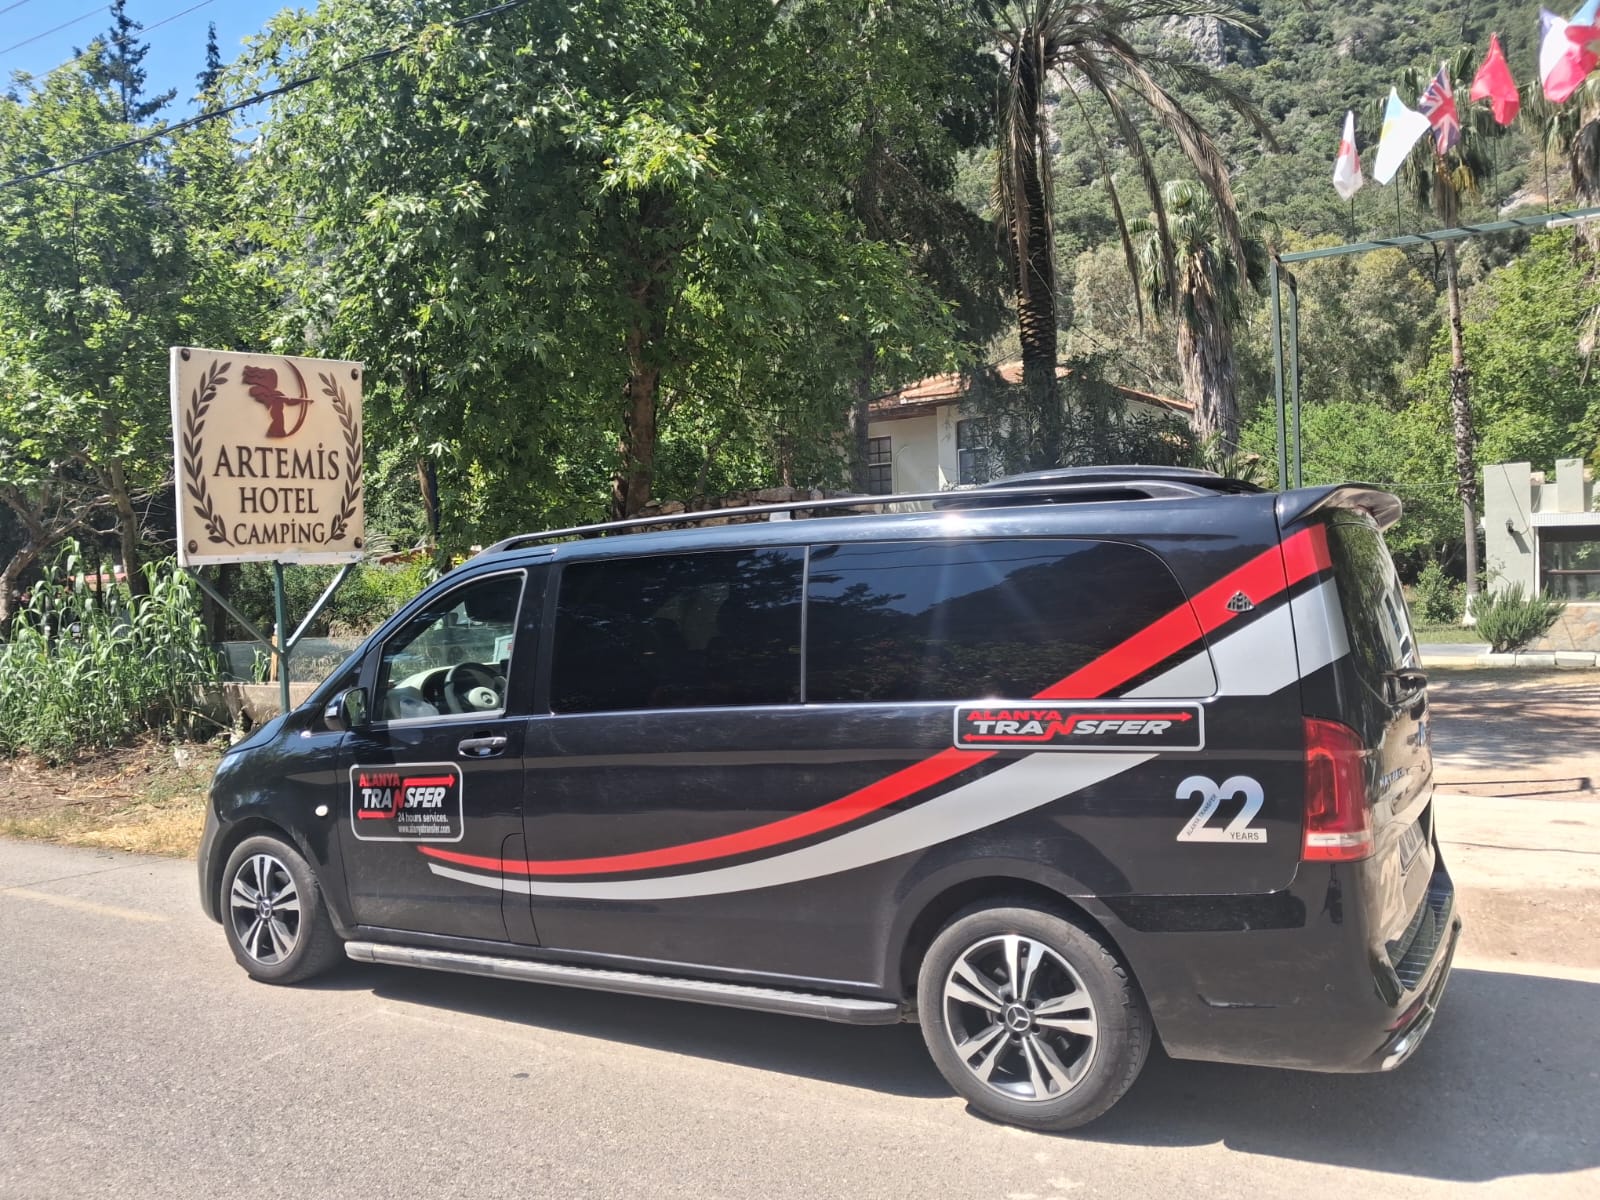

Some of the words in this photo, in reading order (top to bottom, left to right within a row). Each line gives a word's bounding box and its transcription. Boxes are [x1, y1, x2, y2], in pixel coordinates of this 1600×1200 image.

[212, 443, 340, 481] ARTEMİS
[239, 487, 319, 514] HOTEL
[233, 519, 325, 545] CAMPİNG
[966, 710, 1062, 721] ALANYA
[974, 720, 1172, 735] TRANSFER
[359, 773, 400, 787] ALANYA
[361, 787, 446, 808] TRANSFER
[398, 812, 405, 822] 24
[405, 812, 422, 822] hours
[1175, 775, 1267, 843] 22
[1230, 832, 1259, 840] YEARS
